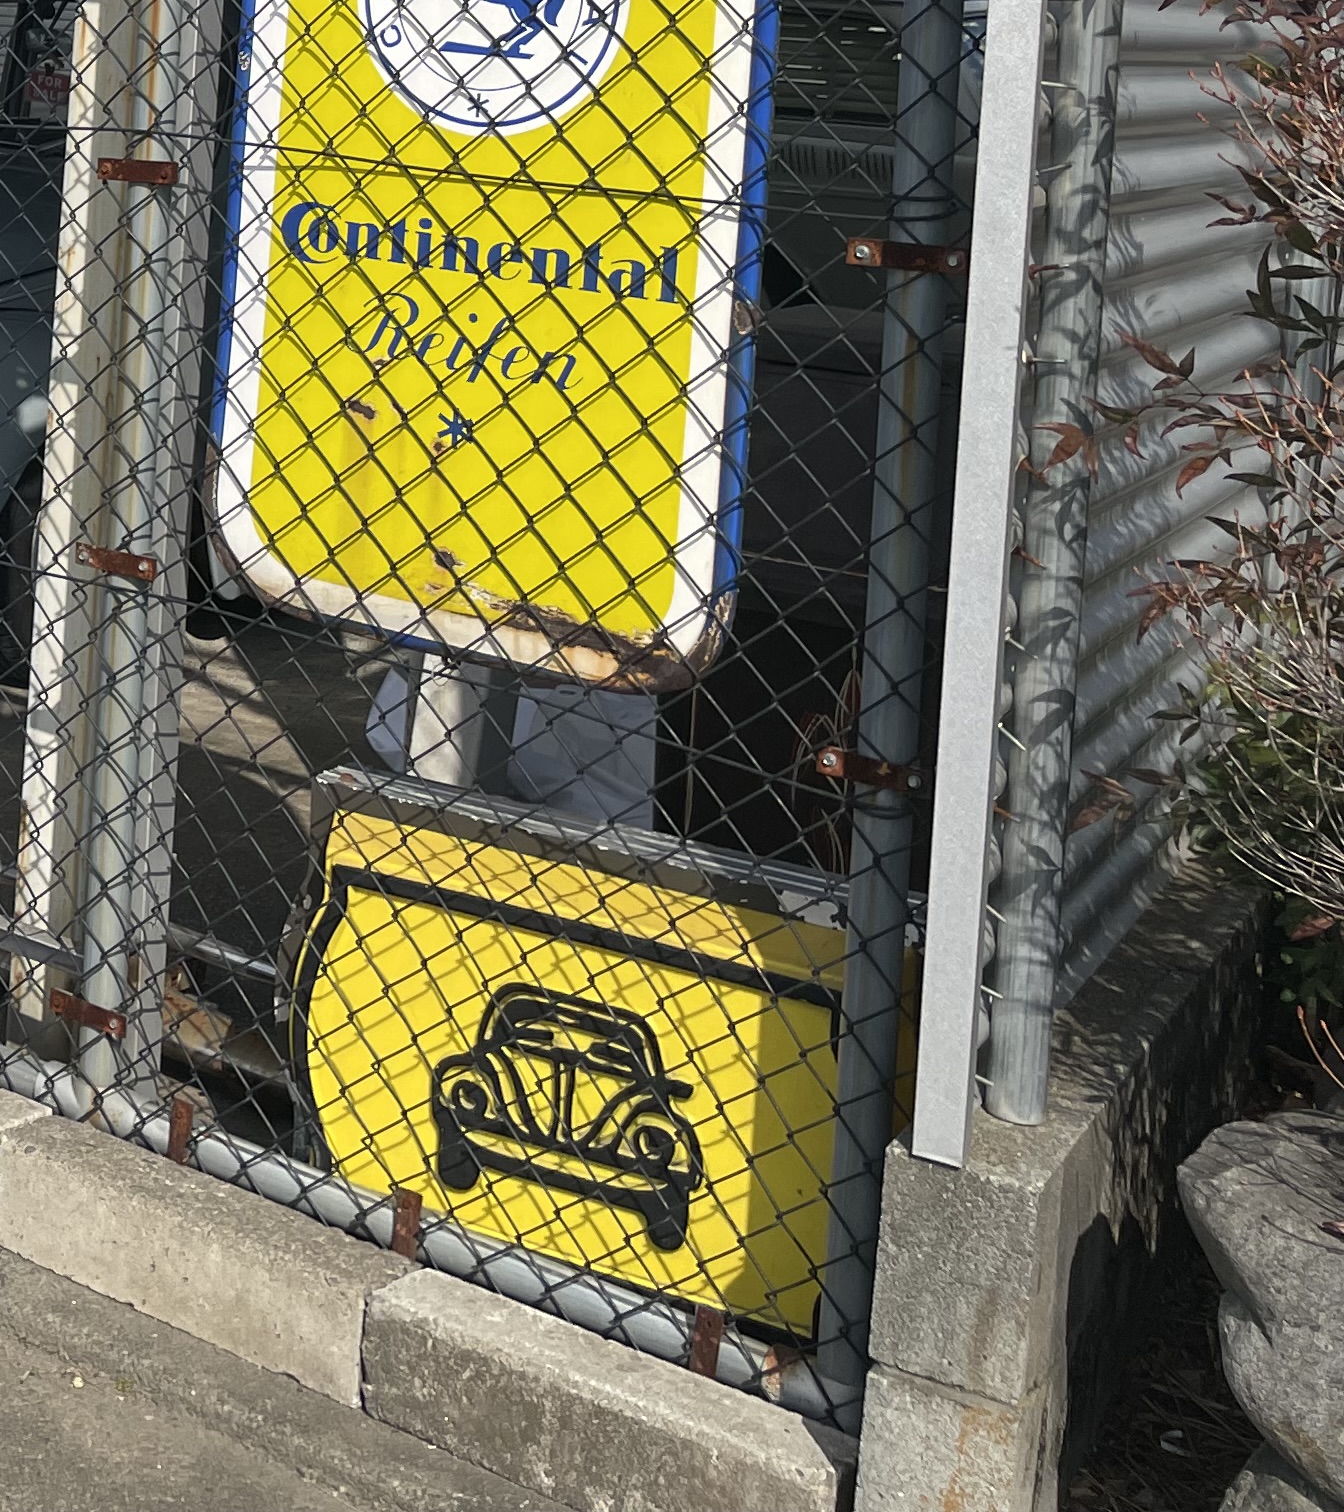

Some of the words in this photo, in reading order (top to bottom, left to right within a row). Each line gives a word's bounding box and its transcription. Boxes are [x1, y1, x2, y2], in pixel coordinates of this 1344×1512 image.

[37, 74, 62, 88] FOR
[281, 201, 681, 304] Continental
[346, 292, 583, 390] Reifen
